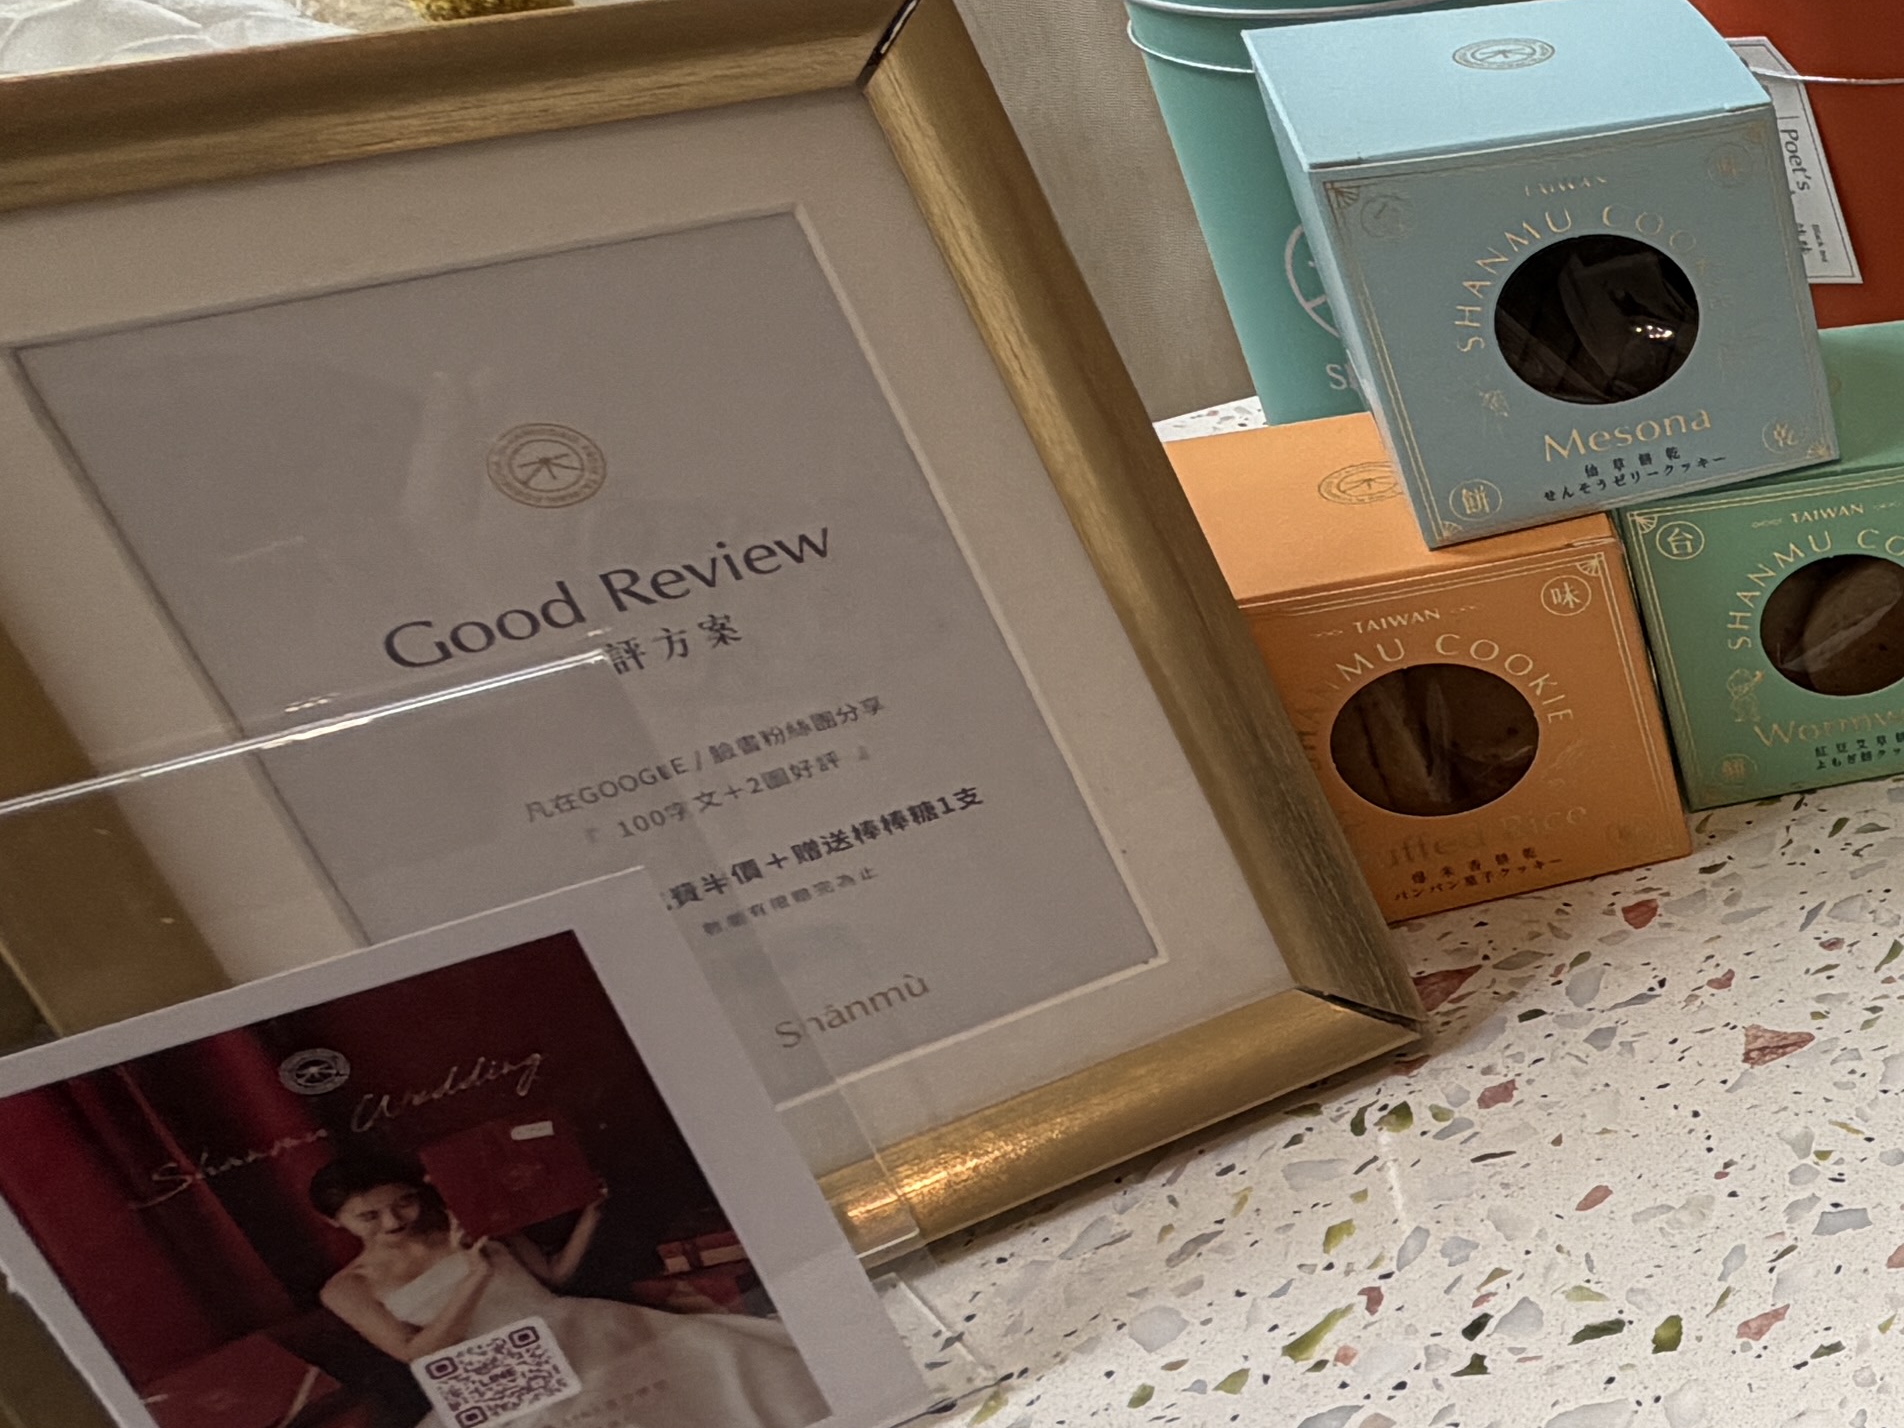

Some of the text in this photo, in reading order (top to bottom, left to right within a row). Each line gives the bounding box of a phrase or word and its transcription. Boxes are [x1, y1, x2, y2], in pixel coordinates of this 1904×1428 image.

[1780, 129, 1812, 192] Poet's
[1454, 207, 1573, 353] SHANMU
[1542, 409, 1713, 463] Mesona
[1790, 503, 1865, 524] TAIWAN
[384, 526, 829, 670] Good Review
[1352, 608, 1442, 635] TAIWAN
[1726, 530, 1833, 651] SHANMU
[1434, 632, 1574, 725] COOKIE
[661, 785, 985, 912] 費半價+贈送棒棒糖1支
